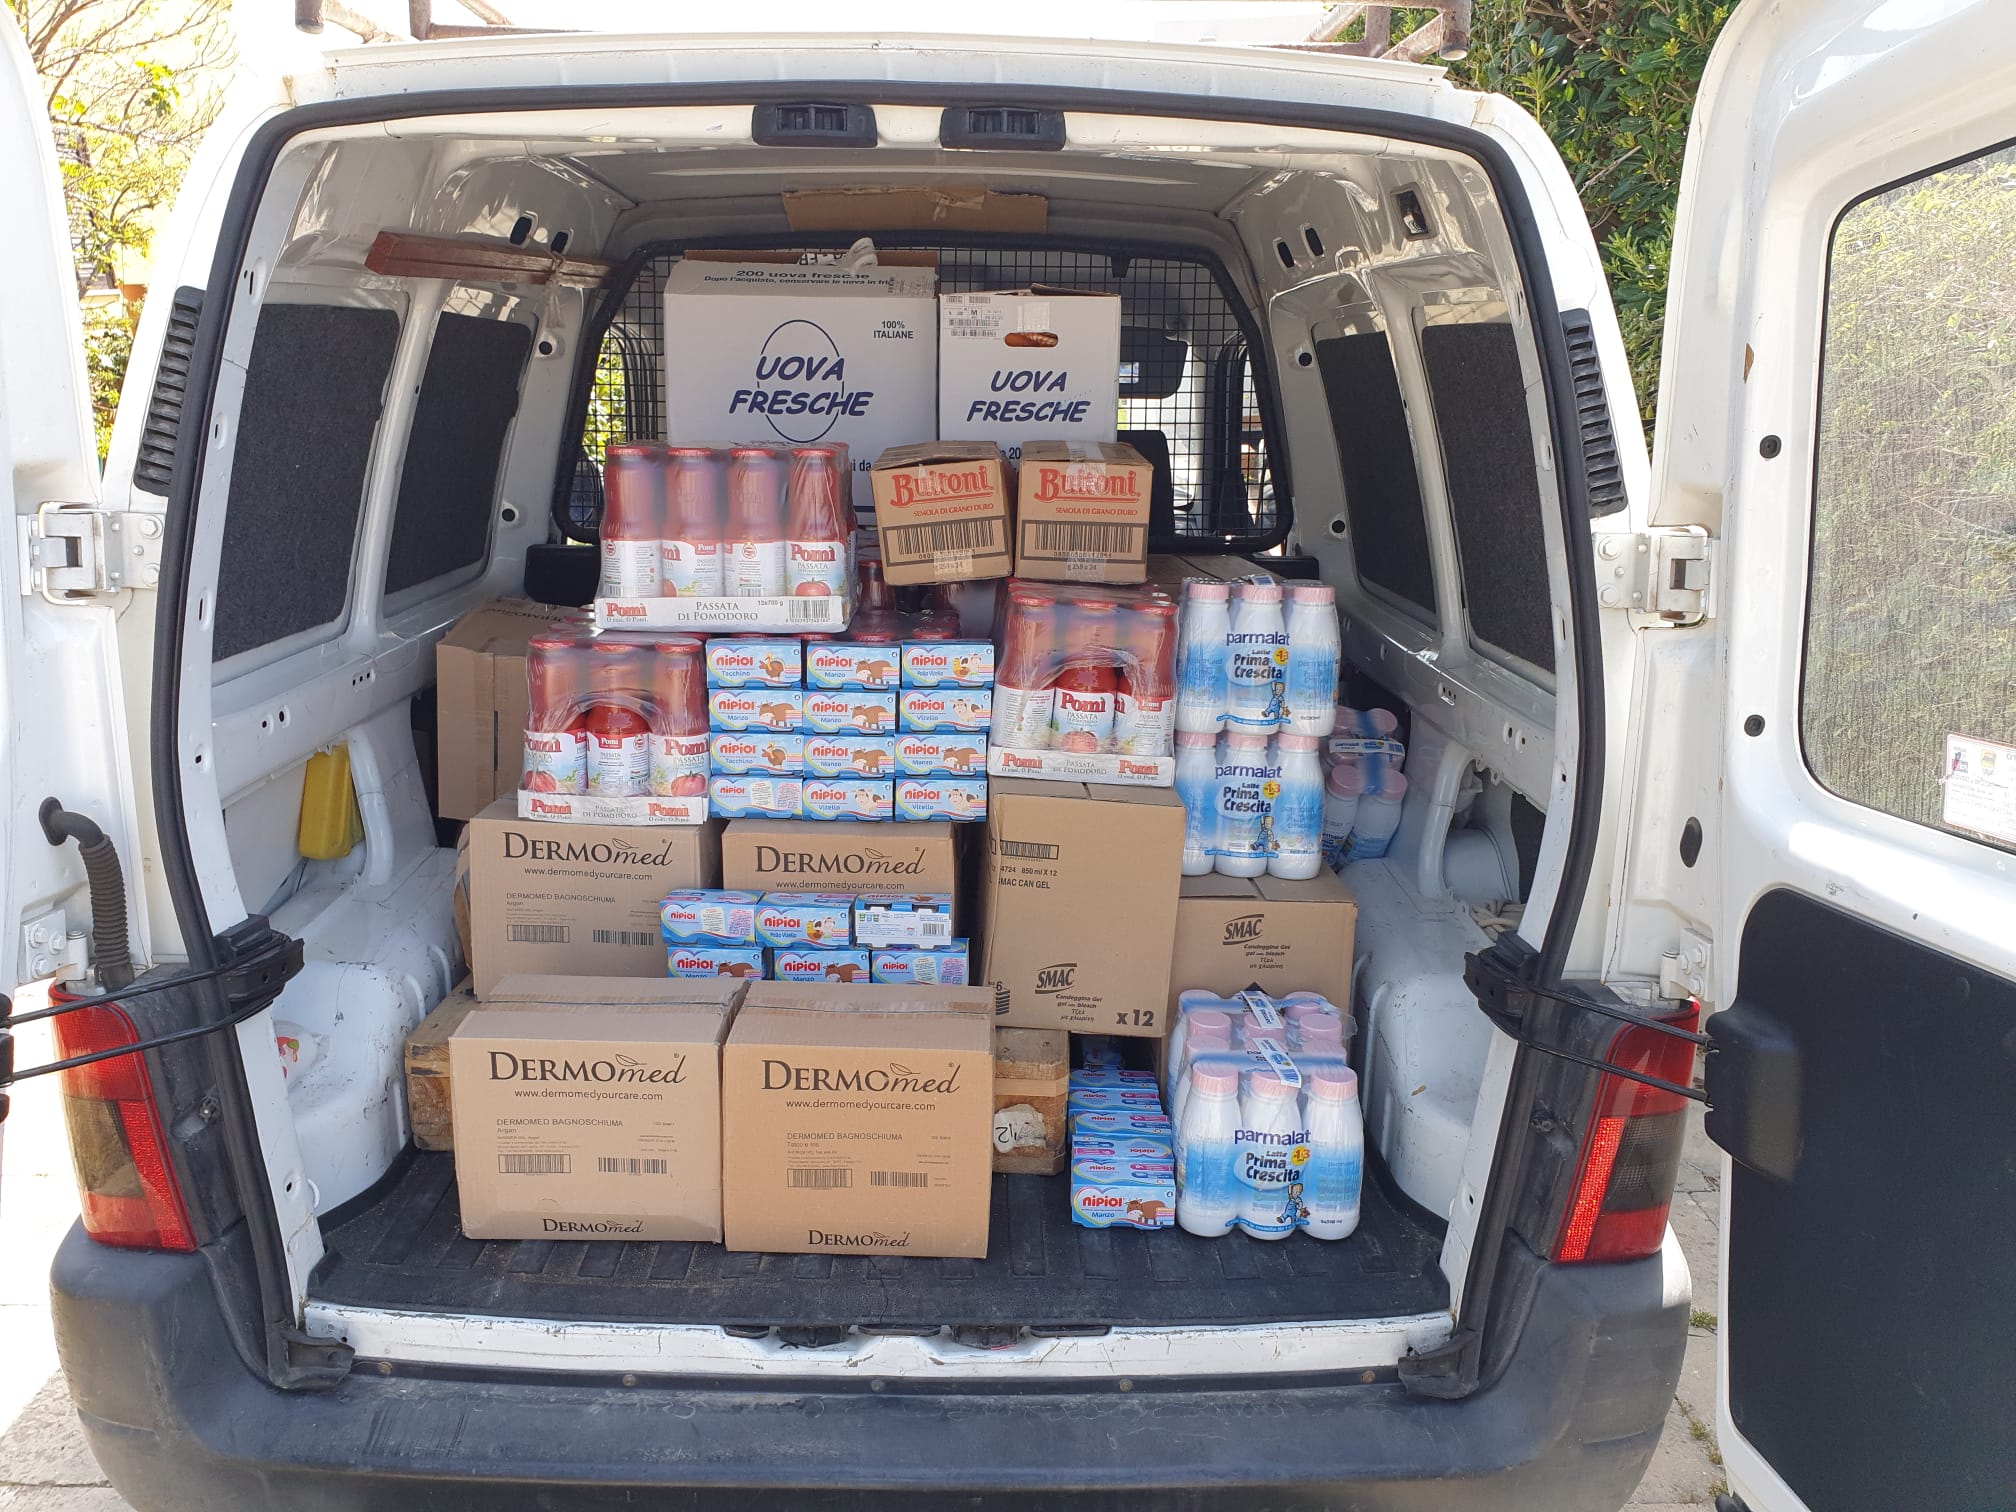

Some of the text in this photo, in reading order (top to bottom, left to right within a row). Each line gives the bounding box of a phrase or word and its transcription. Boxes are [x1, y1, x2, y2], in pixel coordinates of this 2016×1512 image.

[881, 320, 905, 329] 100%
[873, 330, 914, 339] ITALIANE
[755, 355, 845, 381] UOVA
[991, 370, 1067, 392] UOVA
[729, 389, 874, 416] FRESCHE
[967, 400, 1091, 422] FRESCHE
[913, 509, 939, 517] SEMOLA
[949, 505, 973, 514] GRANO
[974, 503, 994, 512] DURO
[1056, 507, 1082, 515] SEMOLA
[696, 601, 739, 610] PASSATA
[678, 612, 758, 620] DI POMODORO
[1226, 632, 1290, 646] parmalat
[1234, 654, 1270, 666] Prima
[1234, 667, 1283, 679] Crescita
[1060, 691, 1106, 713] Pomì
[1215, 765, 1282, 779] parmalat
[1223, 786, 1259, 800] Prima
[1224, 799, 1271, 812] Crescita
[502, 831, 673, 866] DERMOmed
[755, 845, 927, 875] DERMOmed
[524, 867, 653, 881] www.dermomedyourcare.com
[776, 880, 905, 890] www.dermomedyourcare.com
[1018, 879, 1034, 888] CAN
[1036, 880, 1051, 889] GEL
[506, 892, 616, 904] DERMOMED BAGNOSCHIUMA
[1224, 918, 1264, 941] SMAC
[996, 980, 1003, 991] 6
[1037, 968, 1074, 989] SMAC
[1132, 1009, 1154, 1026] 12
[488, 1051, 687, 1084] DERMOmed
[761, 1059, 961, 1094] DERMOmed
[514, 1088, 663, 1101] www.dermomedyourcare.com
[785, 1099, 936, 1111] www.dermomedyourcare.com
[497, 1118, 623, 1127] DERMOMED BAGNOSCHIUMA
[787, 1132, 903, 1141] DERMOMED BAGNOSCHIUMA
[1234, 1129, 1311, 1146] parmalat
[1246, 1152, 1286, 1169] Prima
[1246, 1165, 1300, 1183] Crescita
